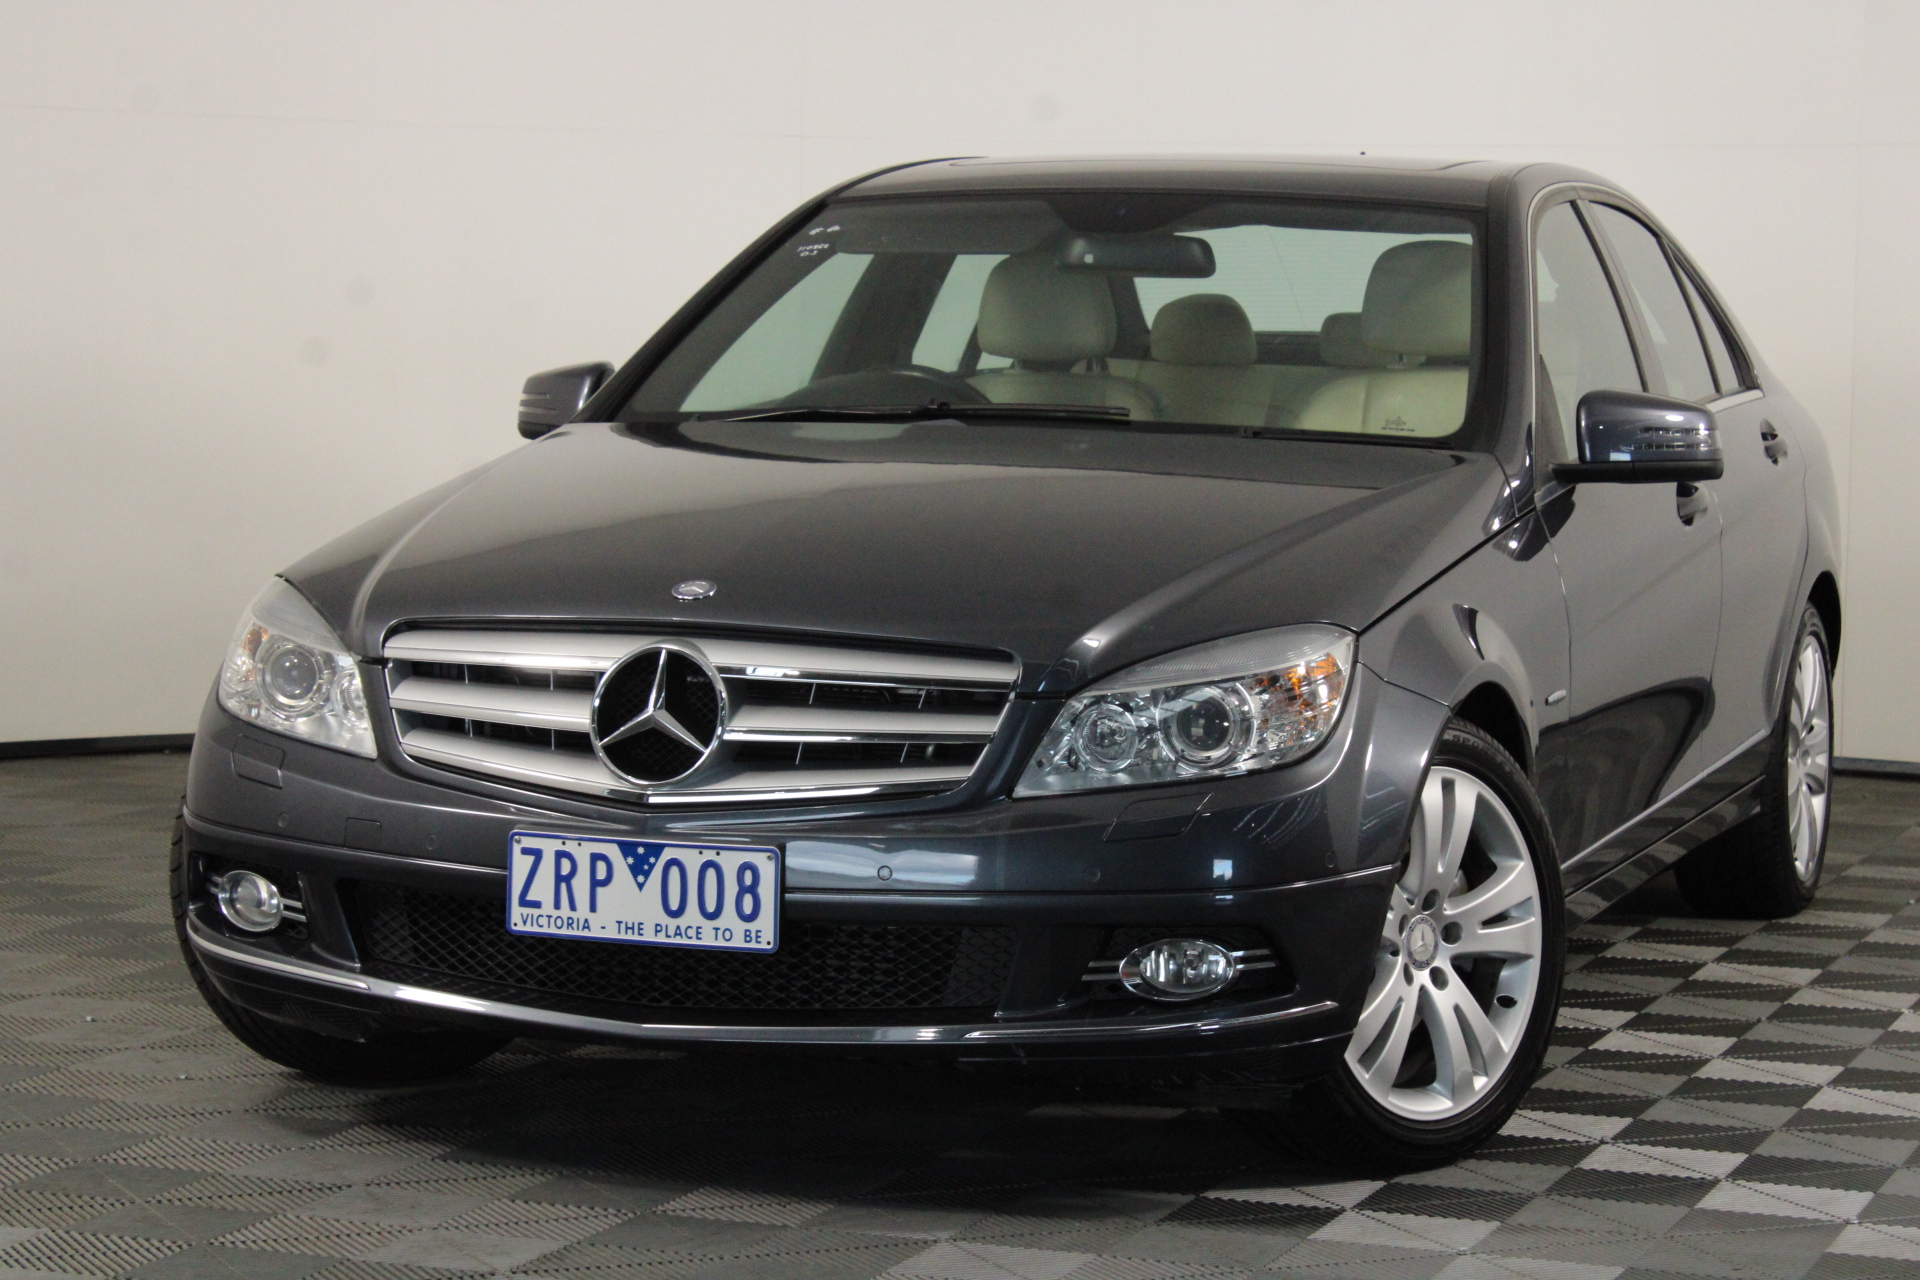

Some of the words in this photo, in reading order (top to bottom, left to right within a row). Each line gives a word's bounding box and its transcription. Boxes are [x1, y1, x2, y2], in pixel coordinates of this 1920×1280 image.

[518, 847, 614, 914] ZRP
[660, 856, 761, 923] 008
[520, 913, 591, 932] VICTORIA
[615, 920, 644, 937] THE
[654, 923, 703, 941] PLACE
[712, 927, 733, 942] TO
[744, 929, 762, 944] BE
